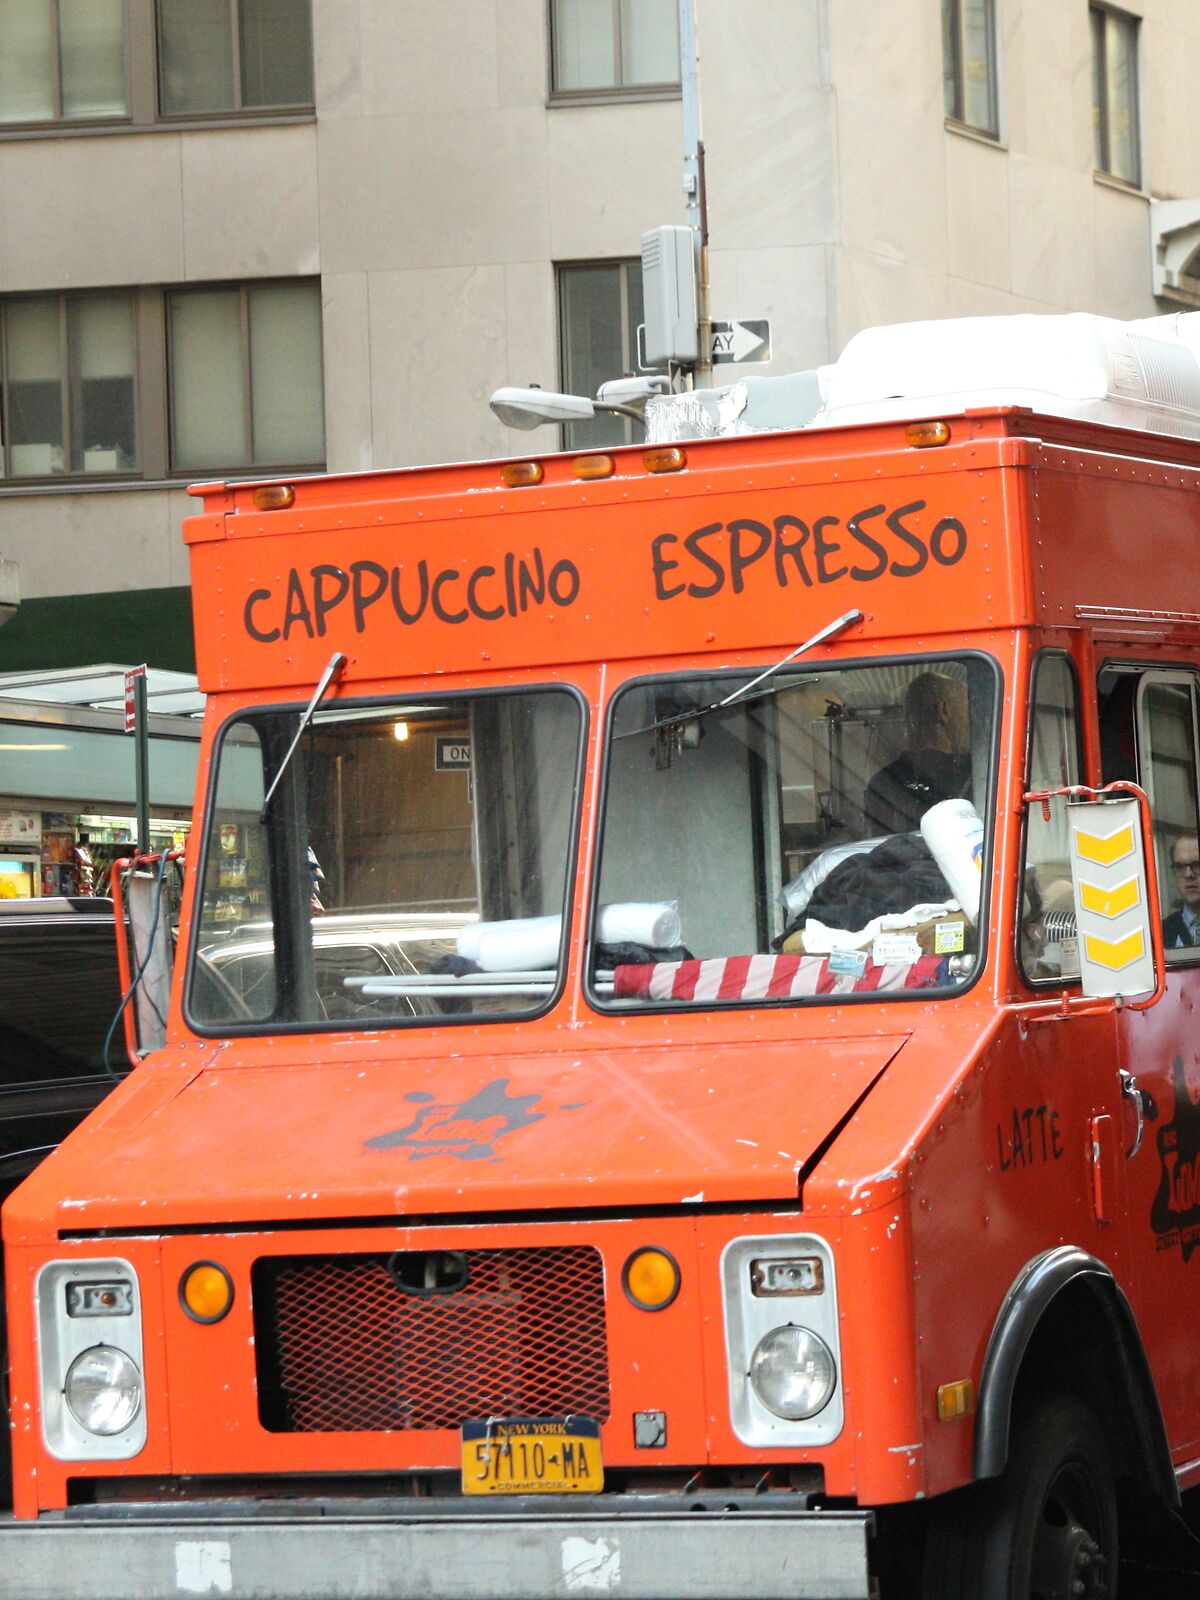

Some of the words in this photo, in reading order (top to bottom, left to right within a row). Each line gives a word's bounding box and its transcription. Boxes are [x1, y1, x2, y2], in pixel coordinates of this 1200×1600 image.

[245, 548, 580, 643] CAPPUCCINO
[653, 499, 968, 601] ESPRESSO
[997, 1105, 1064, 1173] LATTE
[497, 1424, 529, 1436] NEW
[532, 1423, 568, 1435] YORK
